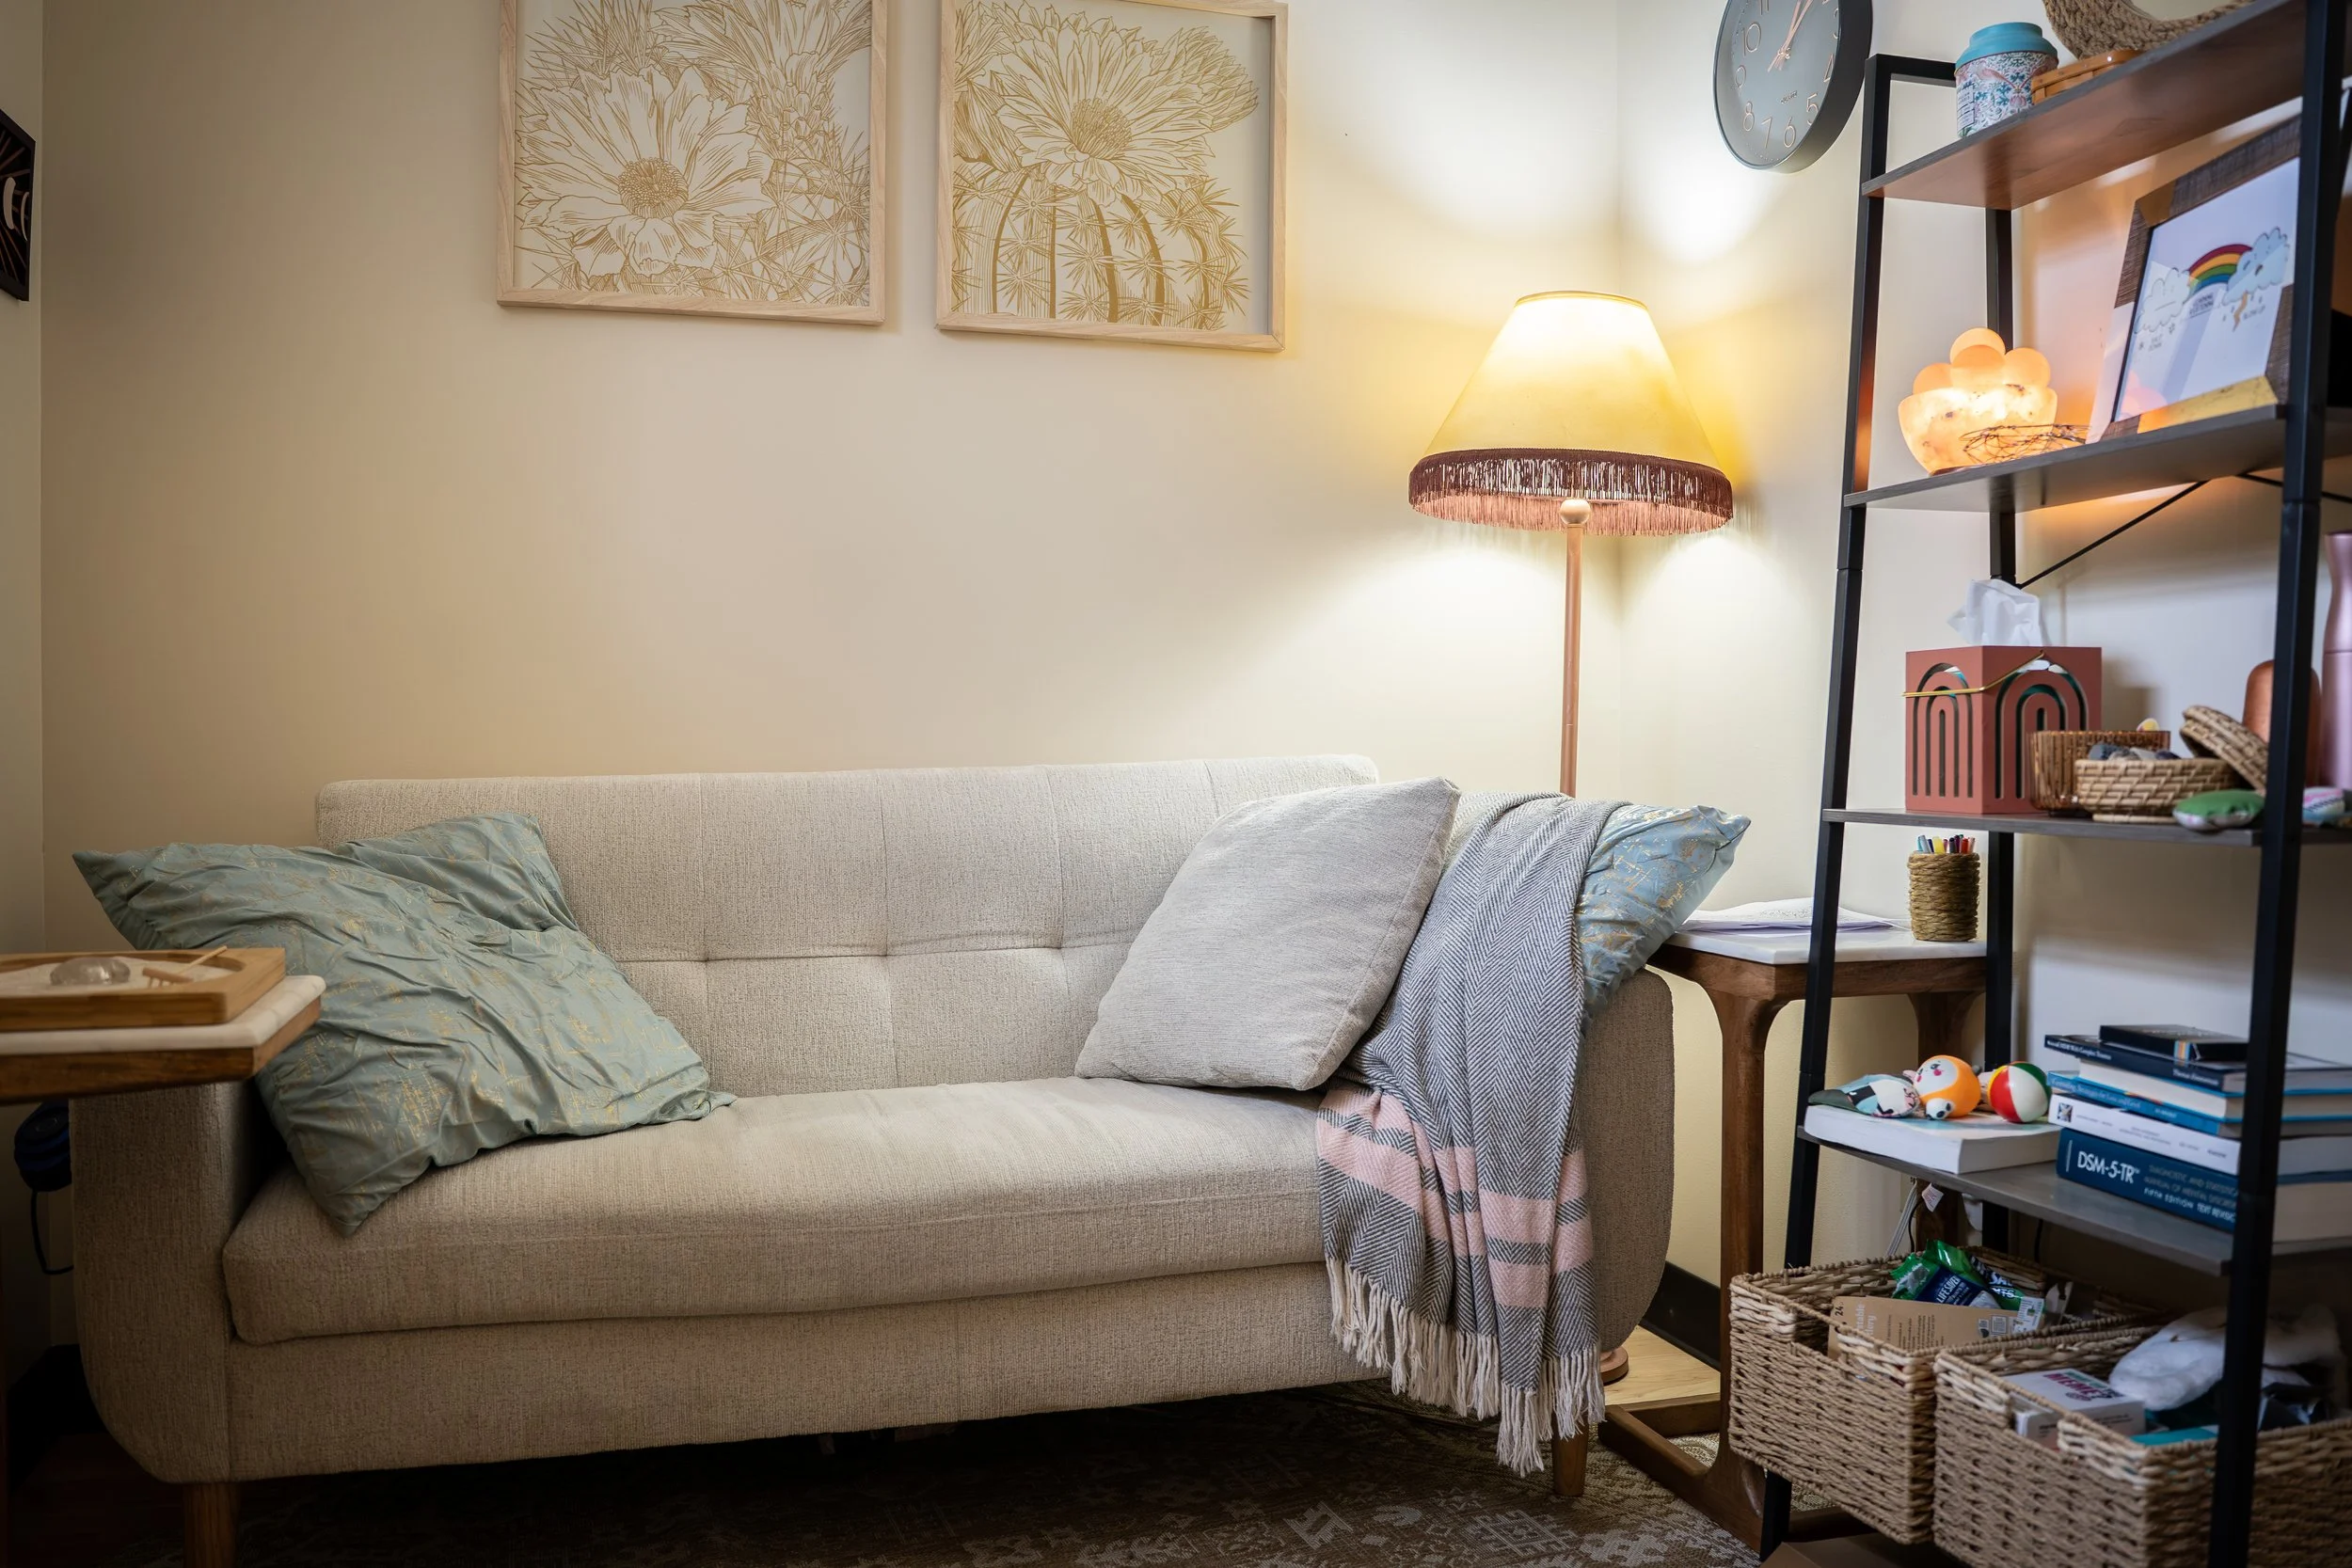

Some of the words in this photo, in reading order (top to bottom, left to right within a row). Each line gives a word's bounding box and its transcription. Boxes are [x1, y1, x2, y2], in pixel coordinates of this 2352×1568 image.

[1741, 22, 1762, 57] 10
[1735, 65, 1746, 97] 9
[1742, 101, 1755, 132] 8
[1806, 93, 1820, 126] 5
[1761, 116, 1773, 149] 7
[1783, 117, 1796, 148] 6
[2143, 1187, 2163, 1200] FIFTH
[2165, 1193, 2195, 1210] EDITION
[2197, 1202, 2213, 1216] TEXT
[1835, 1305, 1844, 1317] 24
